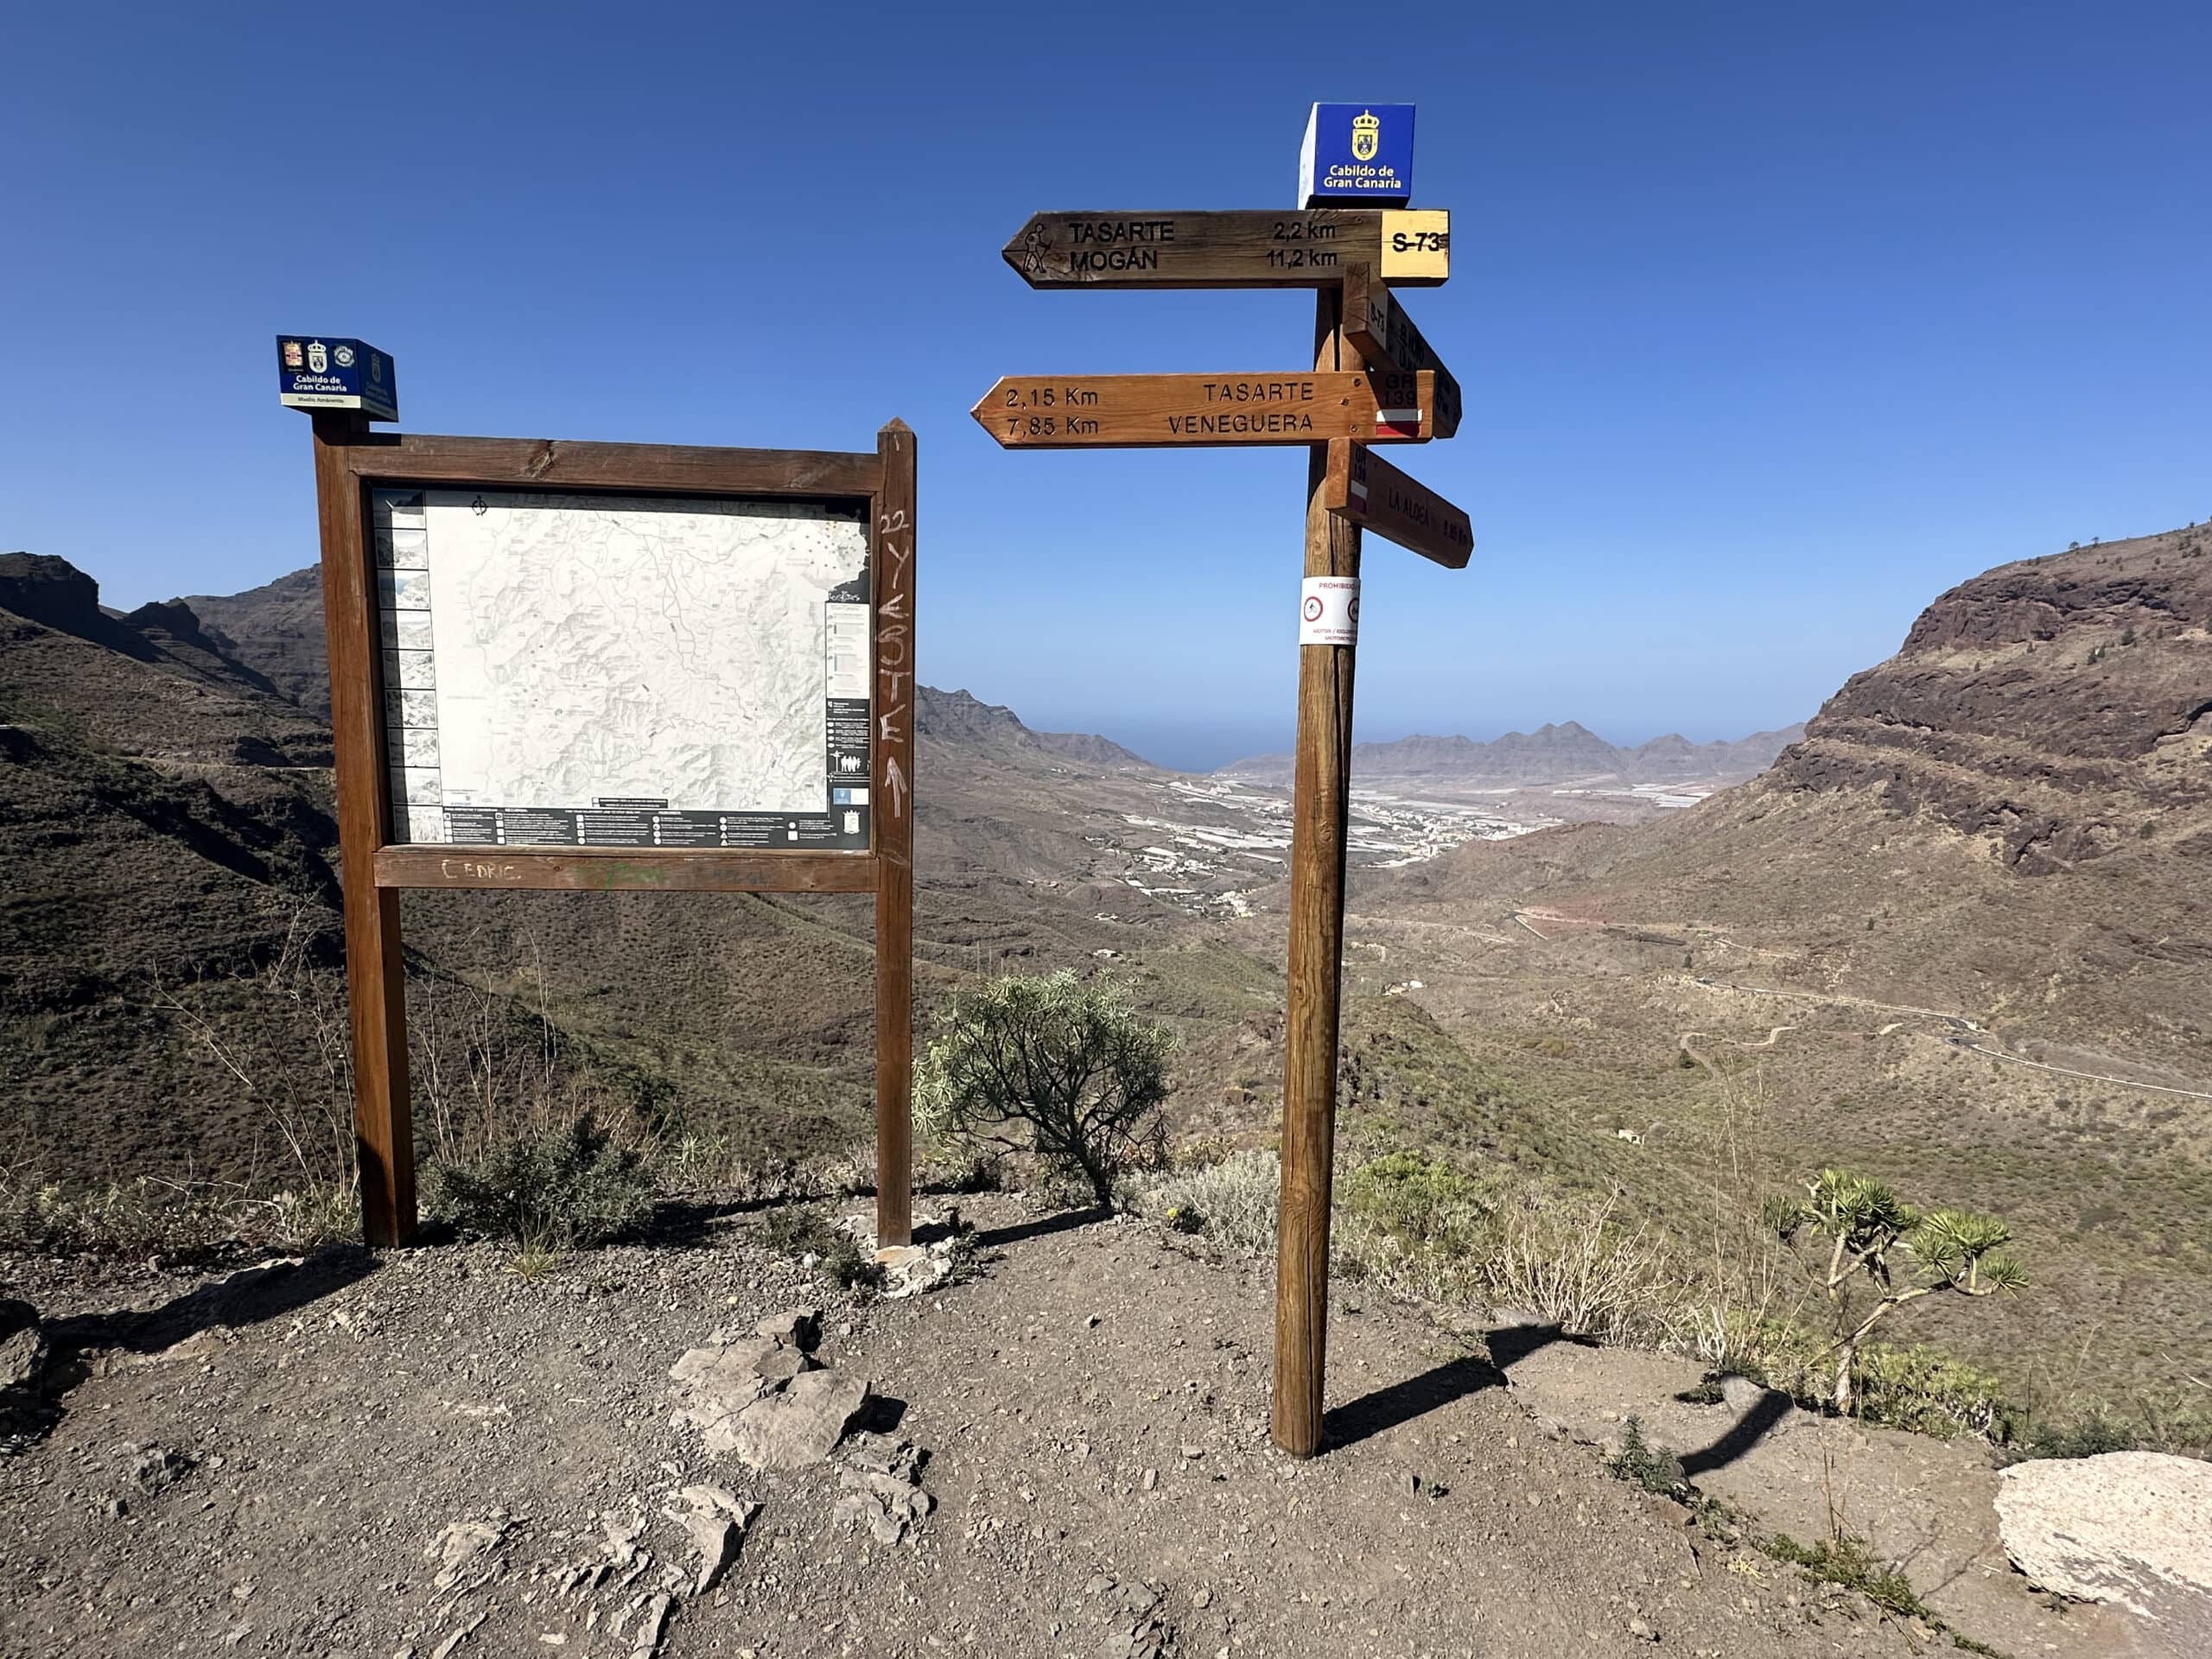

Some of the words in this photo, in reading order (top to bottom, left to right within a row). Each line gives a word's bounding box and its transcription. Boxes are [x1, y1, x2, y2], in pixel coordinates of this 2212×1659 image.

[1330, 164, 1376, 176] Cabildo
[1378, 164, 1394, 176] de
[1324, 176, 1352, 188] Gran
[1355, 177, 1402, 188] Canaria
[1068, 220, 1175, 243] TASARTE
[1273, 221, 1302, 242] 2,2
[1307, 221, 1337, 239] km
[1393, 232, 1440, 252] S-73
[1070, 246, 1158, 271] MOGÁN
[1267, 249, 1303, 270] 11,2
[1309, 249, 1338, 266] km
[296, 374, 329, 384] Cabildo
[1385, 373, 1414, 389] GR
[1006, 388, 1055, 410] 2,15
[1065, 388, 1098, 406] Km
[1204, 383, 1314, 402] TASARTE
[1384, 390, 1416, 405] 139
[1007, 417, 1056, 437] 7,85
[1066, 416, 1099, 434] Km
[1168, 414, 1313, 434] VENEGUERA
